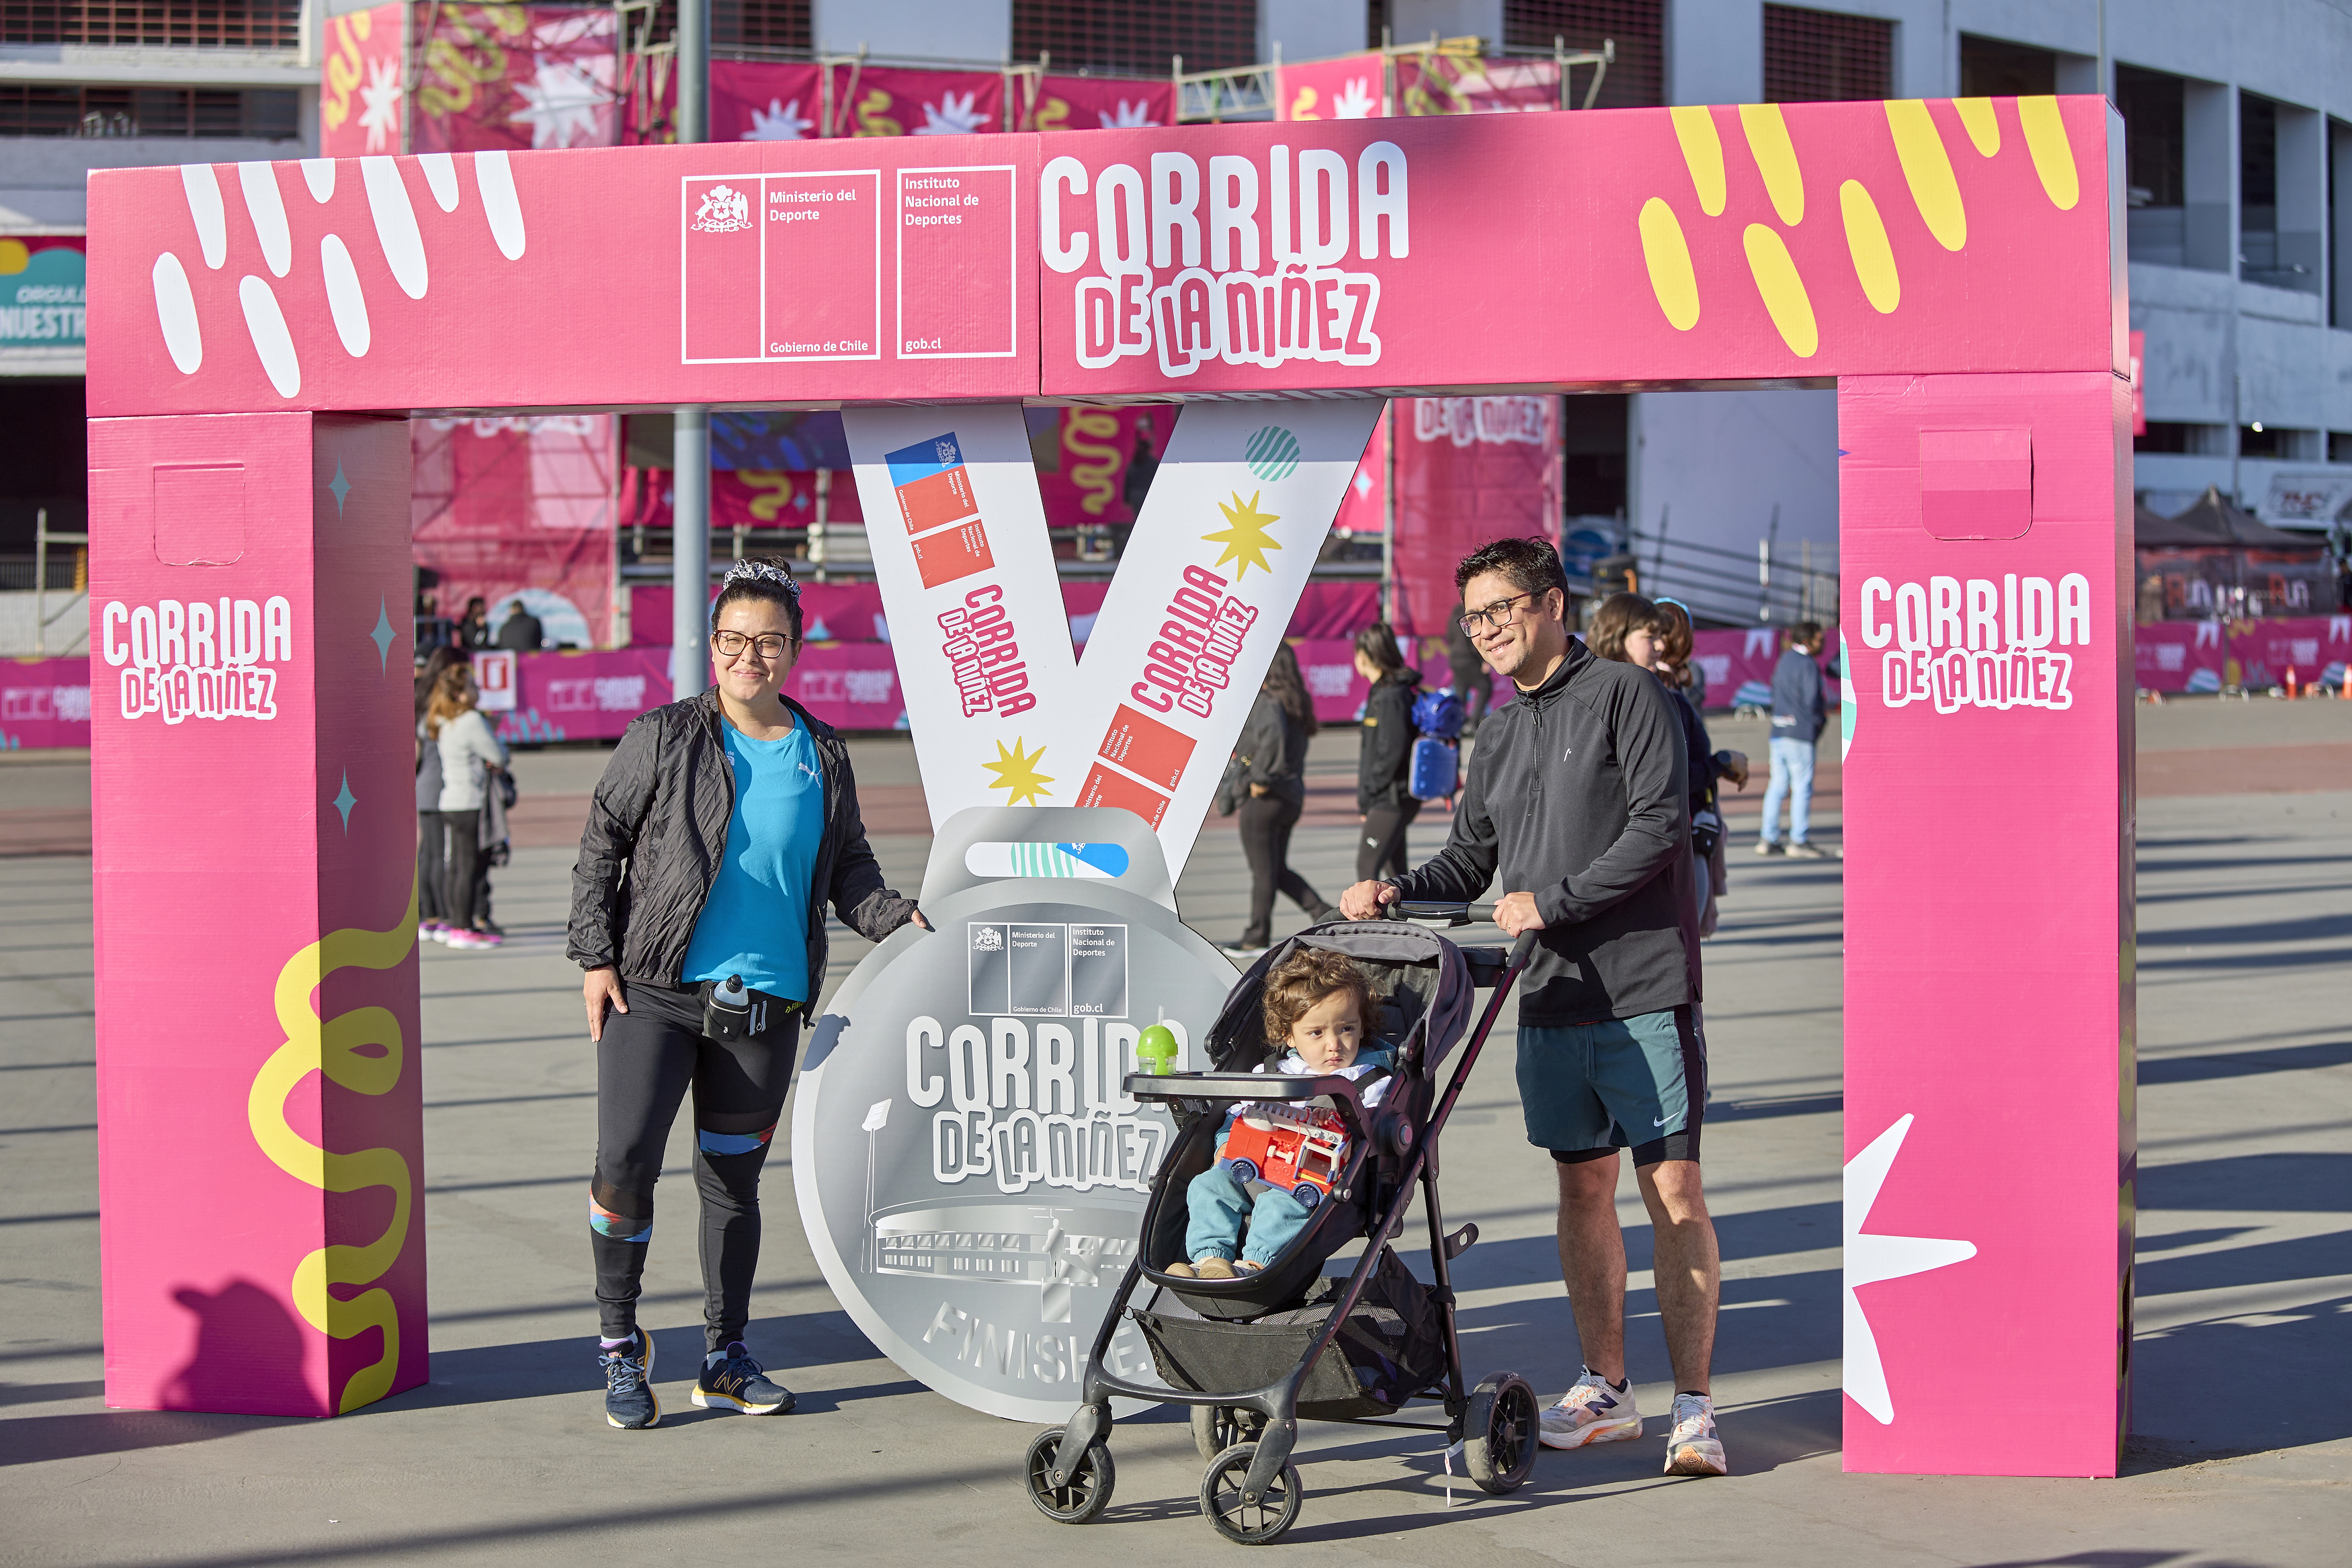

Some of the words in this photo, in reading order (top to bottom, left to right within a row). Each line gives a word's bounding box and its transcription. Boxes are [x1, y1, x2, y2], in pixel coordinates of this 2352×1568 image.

[905, 177, 960, 189] Instituto
[770, 191, 833, 204] Ministerio
[837, 189, 856, 201] del
[905, 195, 960, 208] Nacional
[963, 194, 979, 206] de
[1041, 141, 1409, 275] CORRIDA
[770, 209, 820, 223] Deporte
[905, 213, 962, 228] Deportes
[0, 305, 86, 339] NUESTR
[1080, 269, 1147, 363] DE
[1154, 271, 1215, 373] LA
[1224, 259, 1377, 363] NIÑEZ
[770, 342, 821, 353] Gobierno
[823, 341, 837, 352] de
[839, 339, 868, 351] Chile
[905, 337, 941, 352] gob.cl
[948, 473, 958, 495] Deporte
[954, 471, 967, 499] Ministerio
[898, 489, 908, 511] Gobierno
[960, 528, 972, 553] Deportes
[968, 526, 979, 551] Nacional
[974, 524, 984, 548] Instituto
[913, 543, 924, 560] gob.cl
[938, 608, 974, 638] DE
[1861, 572, 2090, 649] CORRIDA
[103, 595, 291, 667] CORRIDA
[1131, 565, 1228, 713] CORRIDA
[1202, 597, 1257, 664] NIÑEZ
[943, 636, 978, 662] LA
[965, 584, 1036, 717] CORRIDA
[1194, 654, 1229, 689] LA
[1885, 646, 1929, 705] DE
[1933, 649, 1971, 712] LA
[1976, 644, 2070, 709] NIÑEZ
[122, 663, 159, 717] DE
[161, 666, 194, 723] LA
[196, 660, 275, 718] NIÑEZ
[953, 656, 993, 717] NIÑEZ
[1179, 677, 1214, 717] DE
[1103, 729, 1118, 754] Instituto
[1110, 732, 1125, 758] Nacional
[1122, 724, 1129, 733] de
[1118, 736, 1133, 762] Deportes
[1169, 769, 1180, 787] gob.cl
[1083, 785, 1098, 808] inisterio
[1094, 775, 1103, 785] del
[1153, 814, 1160, 822] de
[1156, 800, 1166, 814] Chile
[1073, 928, 1104, 936] Instituto
[1073, 939, 1103, 947] Nacional
[1012, 941, 1038, 949] Deporte
[1073, 949, 1105, 957] Deportes
[1074, 1003, 1103, 1014] gob.cl
[907, 1016, 1188, 1114] CORRID
[936, 1106, 991, 1181] DE
[994, 1110, 1042, 1191] LA
[1044, 1104, 1165, 1191] NIÑEZ
[923, 1301, 1147, 1383] FINISHE
